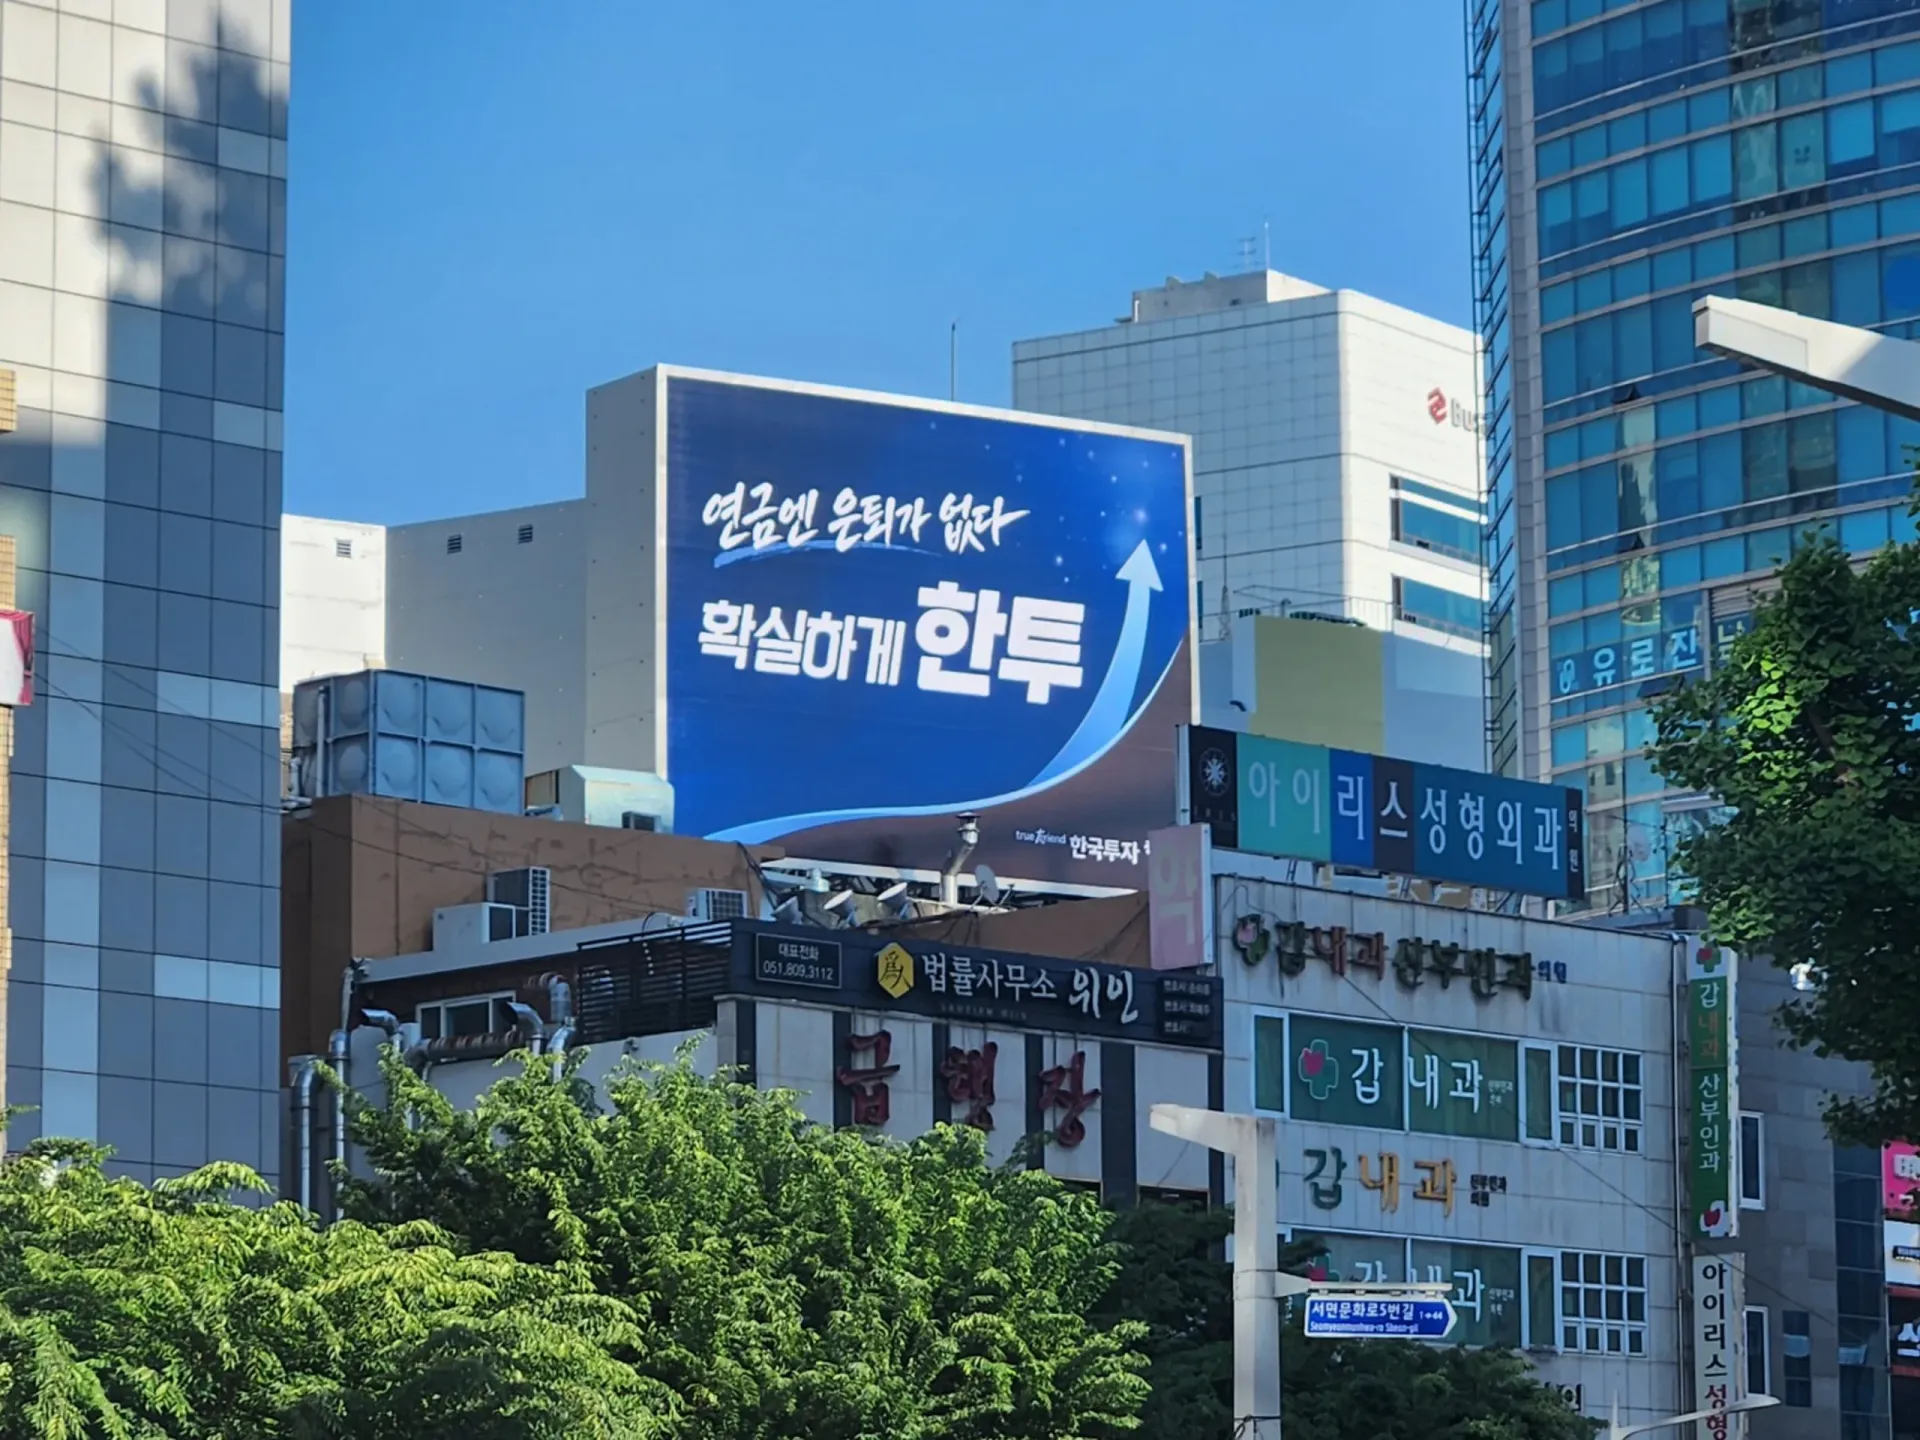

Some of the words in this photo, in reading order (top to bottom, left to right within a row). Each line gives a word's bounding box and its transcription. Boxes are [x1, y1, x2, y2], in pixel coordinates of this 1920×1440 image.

[702, 481, 819, 551] 연금엔
[828, 487, 932, 552] 은퇴가
[938, 493, 1031, 555] 없다
[699, 600, 906, 686] 확실하게
[915, 581, 1085, 705] 한투
[1070, 834, 1140, 865] 한국투자
[1249, 760, 1562, 871] 아이리스성형외과
[763, 960, 834, 981] 051.809.3112
[778, 943, 819, 961] 대표전화
[921, 952, 1057, 1002] 법률사무소
[1068, 966, 1139, 1024] 위인
[1351, 1047, 1484, 1114] 갑내과
[1698, 1073, 1721, 1174] 산부인과
[1303, 1146, 1457, 1219] 갑내과
[1311, 1302, 1415, 1321] 서면문화로5번길
